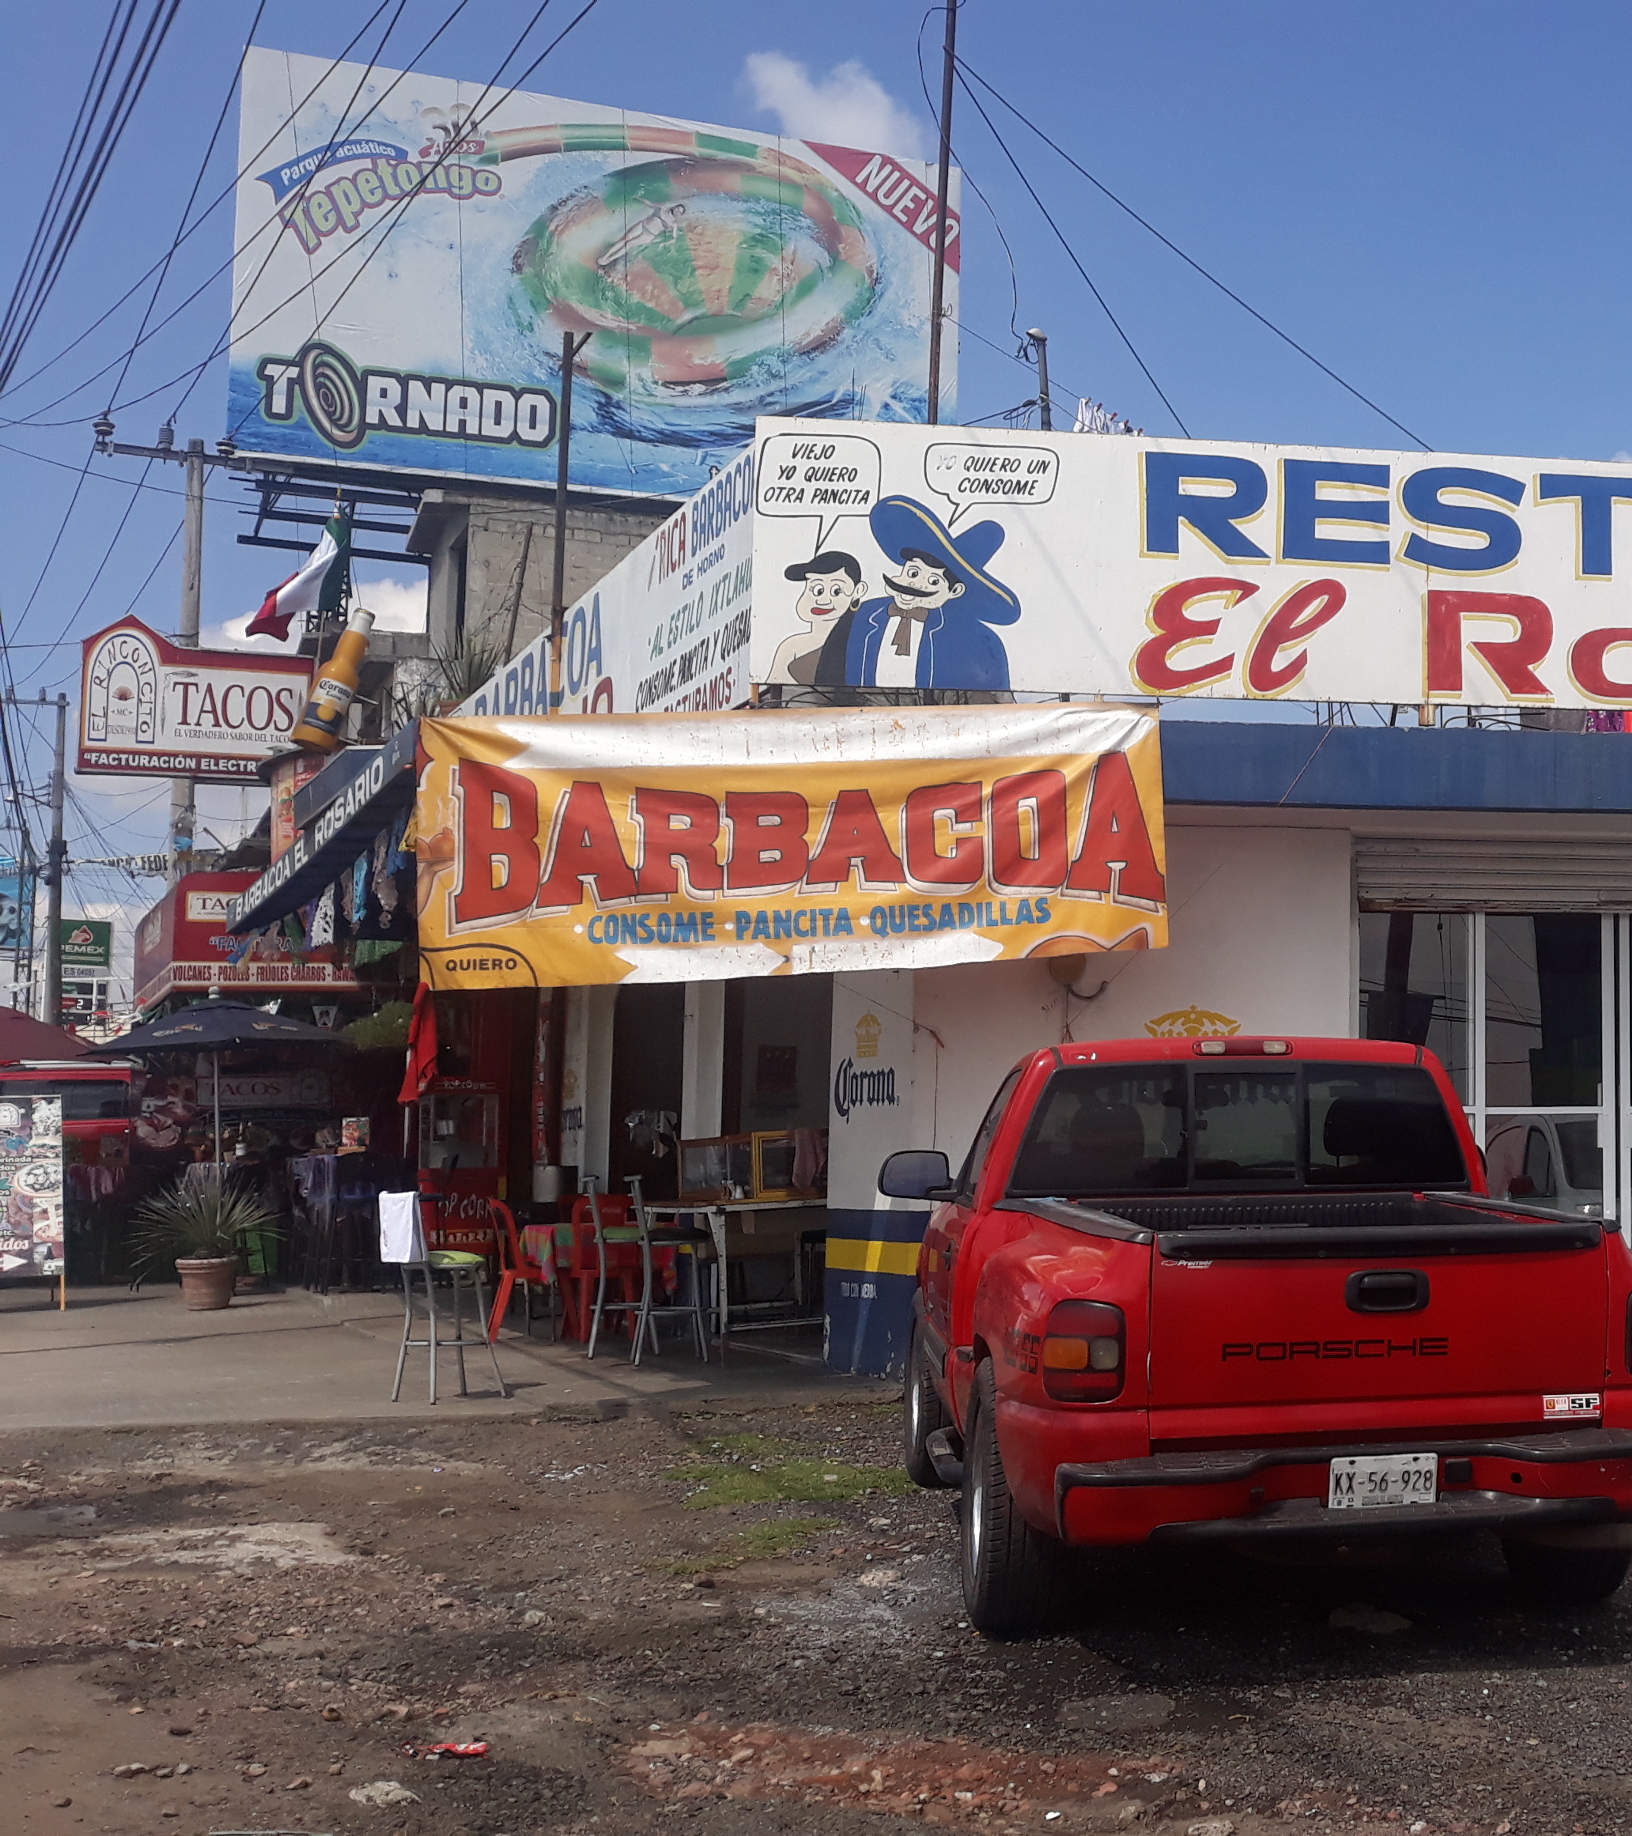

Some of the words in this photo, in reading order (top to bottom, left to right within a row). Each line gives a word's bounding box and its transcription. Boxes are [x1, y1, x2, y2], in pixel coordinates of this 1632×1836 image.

[336, 141, 396, 158] acuático
[279, 158, 502, 254] Tepetongo
[855, 154, 960, 249] NUEVO
[259, 341, 557, 449] TORNADO
[792, 443, 836, 460] VIEJO
[936, 455, 957, 471] YO
[963, 456, 1021, 474] QUIERO
[1027, 459, 1051, 475] UN
[778, 465, 796, 481] YO
[804, 466, 857, 483] QUIERO
[958, 478, 1038, 496] CONSOME
[763, 487, 804, 504] OTRA
[811, 488, 871, 505] PANCITA
[682, 568, 694, 590] DE
[696, 543, 726, 578] HORNO
[667, 591, 704, 649] ESTILO
[1131, 577, 1347, 699] El
[677, 635, 710, 688] PANCITA
[711, 630, 721, 668] Y
[93, 640, 154, 734] RINCONCITO
[91, 705, 106, 732] EL
[172, 681, 294, 733] TACOS
[174, 728, 183, 737] EL
[184, 729, 229, 740] VERDADERO
[230, 731, 254, 742] SABOR
[254, 734, 268, 743] DEL
[200, 759, 260, 773] ELECTR
[235, 854, 291, 921] BARBACOA
[294, 836, 309, 871] EL
[314, 755, 384, 851] ROSARIO
[448, 750, 1167, 936] BARBACOA
[587, 913, 715, 945] CONSOME
[733, 907, 854, 941] PANCITA
[868, 897, 1052, 935] QUESADILLAS
[61, 945, 105, 954] EMEX
[172, 965, 212, 982] VOLCANES
[445, 957, 518, 971] QUIERO
[206, 1081, 281, 1096] TACOS
[834, 1056, 897, 1124] Corona
[1222, 1338, 1449, 1362] PORSCHE
[1333, 1469, 1434, 1496] KX-56-928
